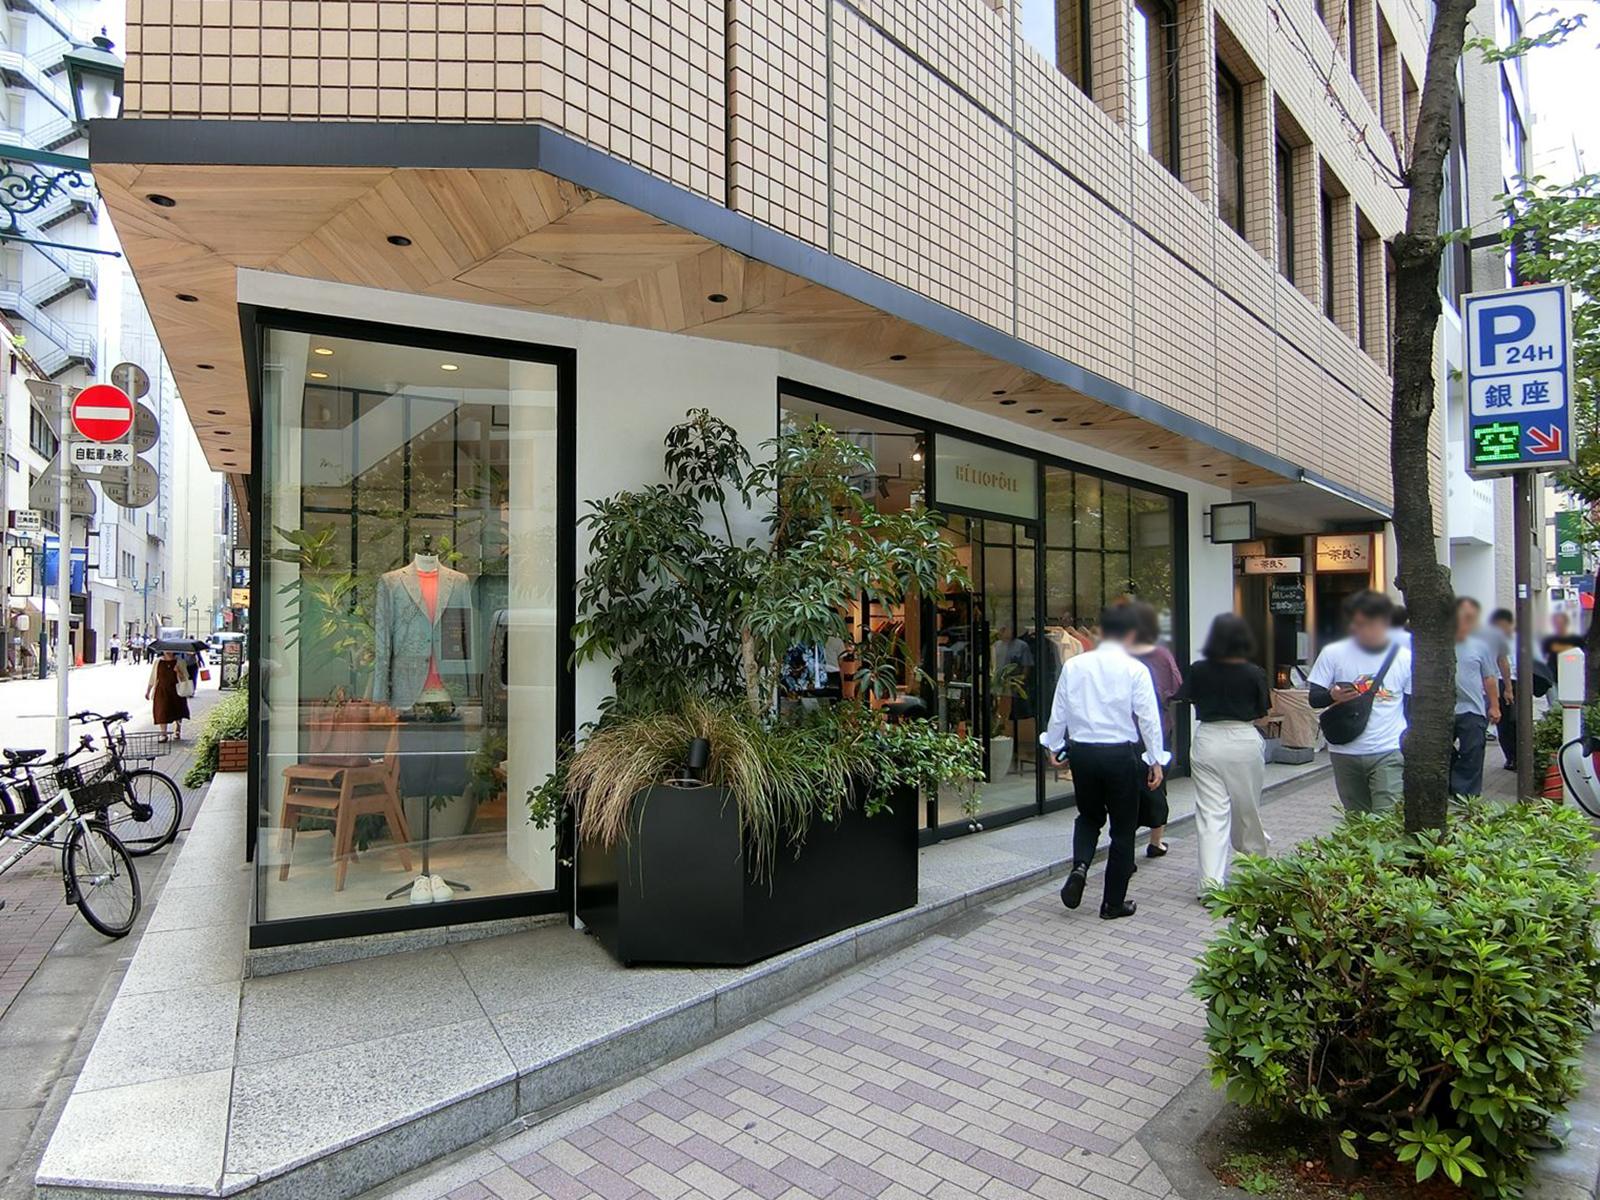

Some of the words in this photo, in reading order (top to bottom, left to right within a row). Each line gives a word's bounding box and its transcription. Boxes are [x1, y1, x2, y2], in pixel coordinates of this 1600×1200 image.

[1478, 305, 1536, 367] P
[1506, 345, 1553, 364] 24H
[1485, 381, 1550, 409] 銀座
[76, 447, 129, 462] 自転車を除く
[1474, 422, 1520, 462] 空
[16, 559, 28, 585] はなび
